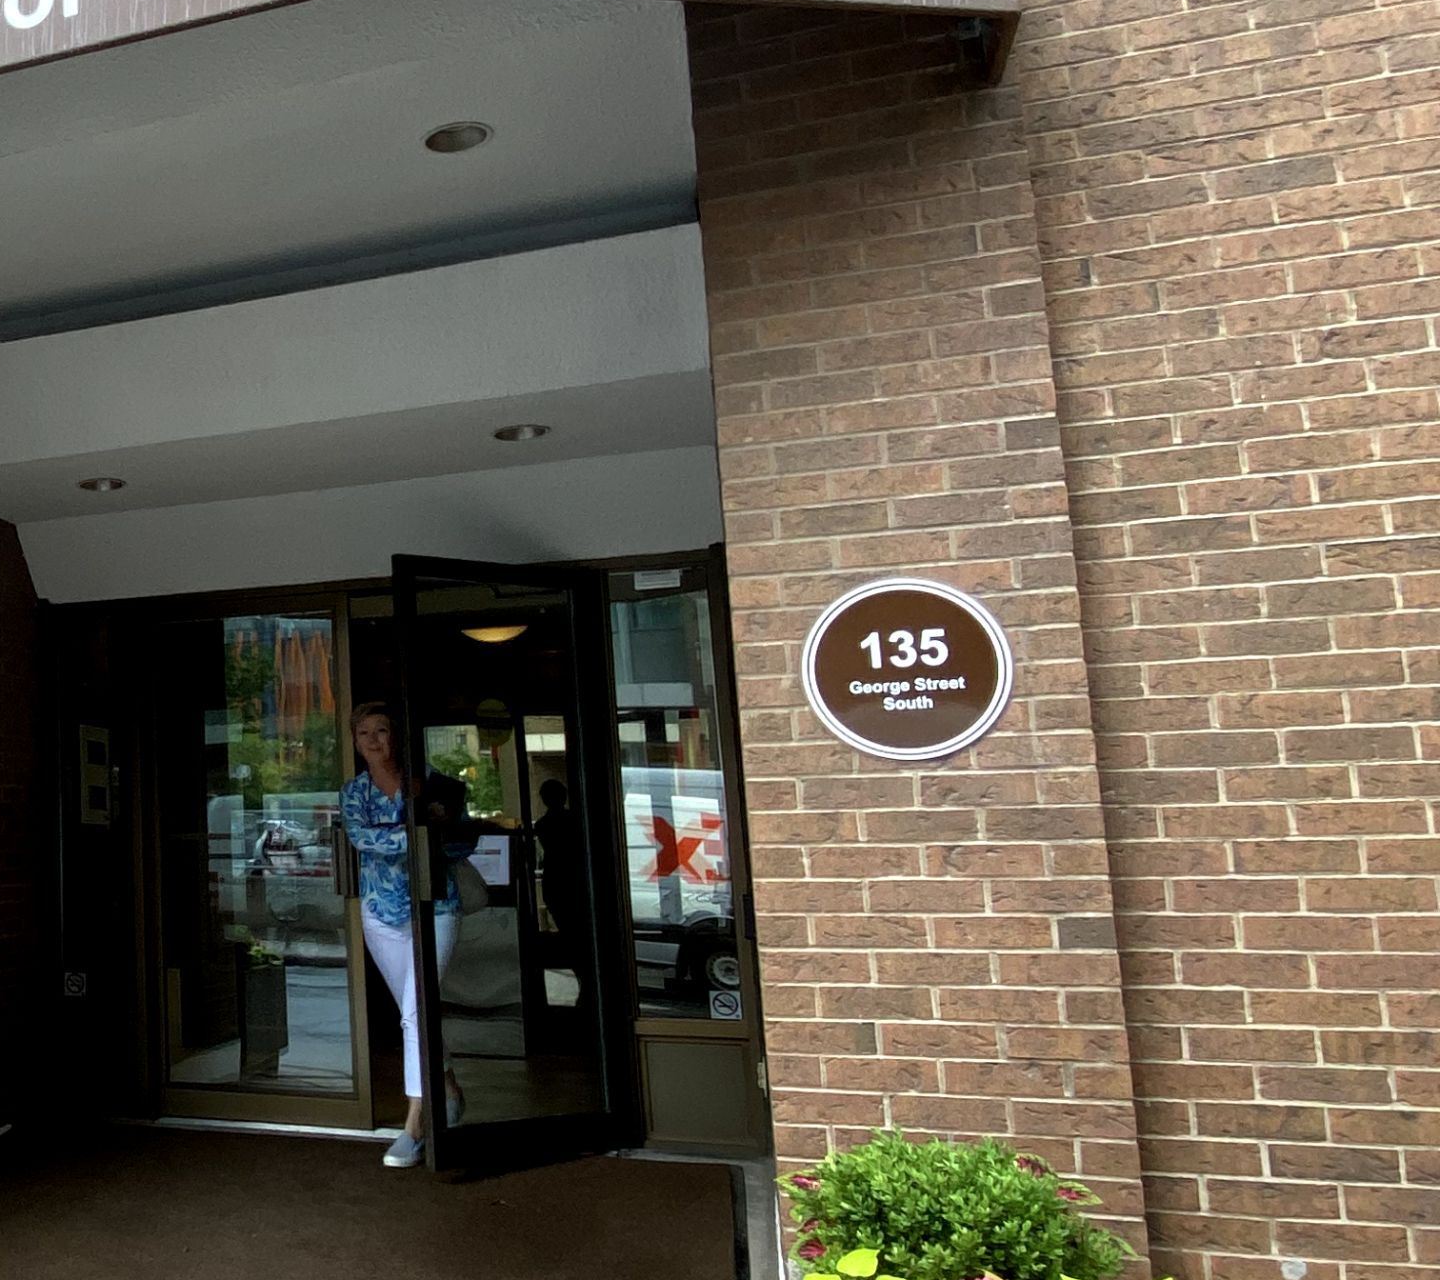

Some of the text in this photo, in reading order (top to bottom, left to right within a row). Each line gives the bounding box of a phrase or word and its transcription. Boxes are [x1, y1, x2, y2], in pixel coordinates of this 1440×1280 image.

[860, 628, 949, 670] 135
[848, 676, 966, 696] George Street
[883, 694, 934, 712] South
